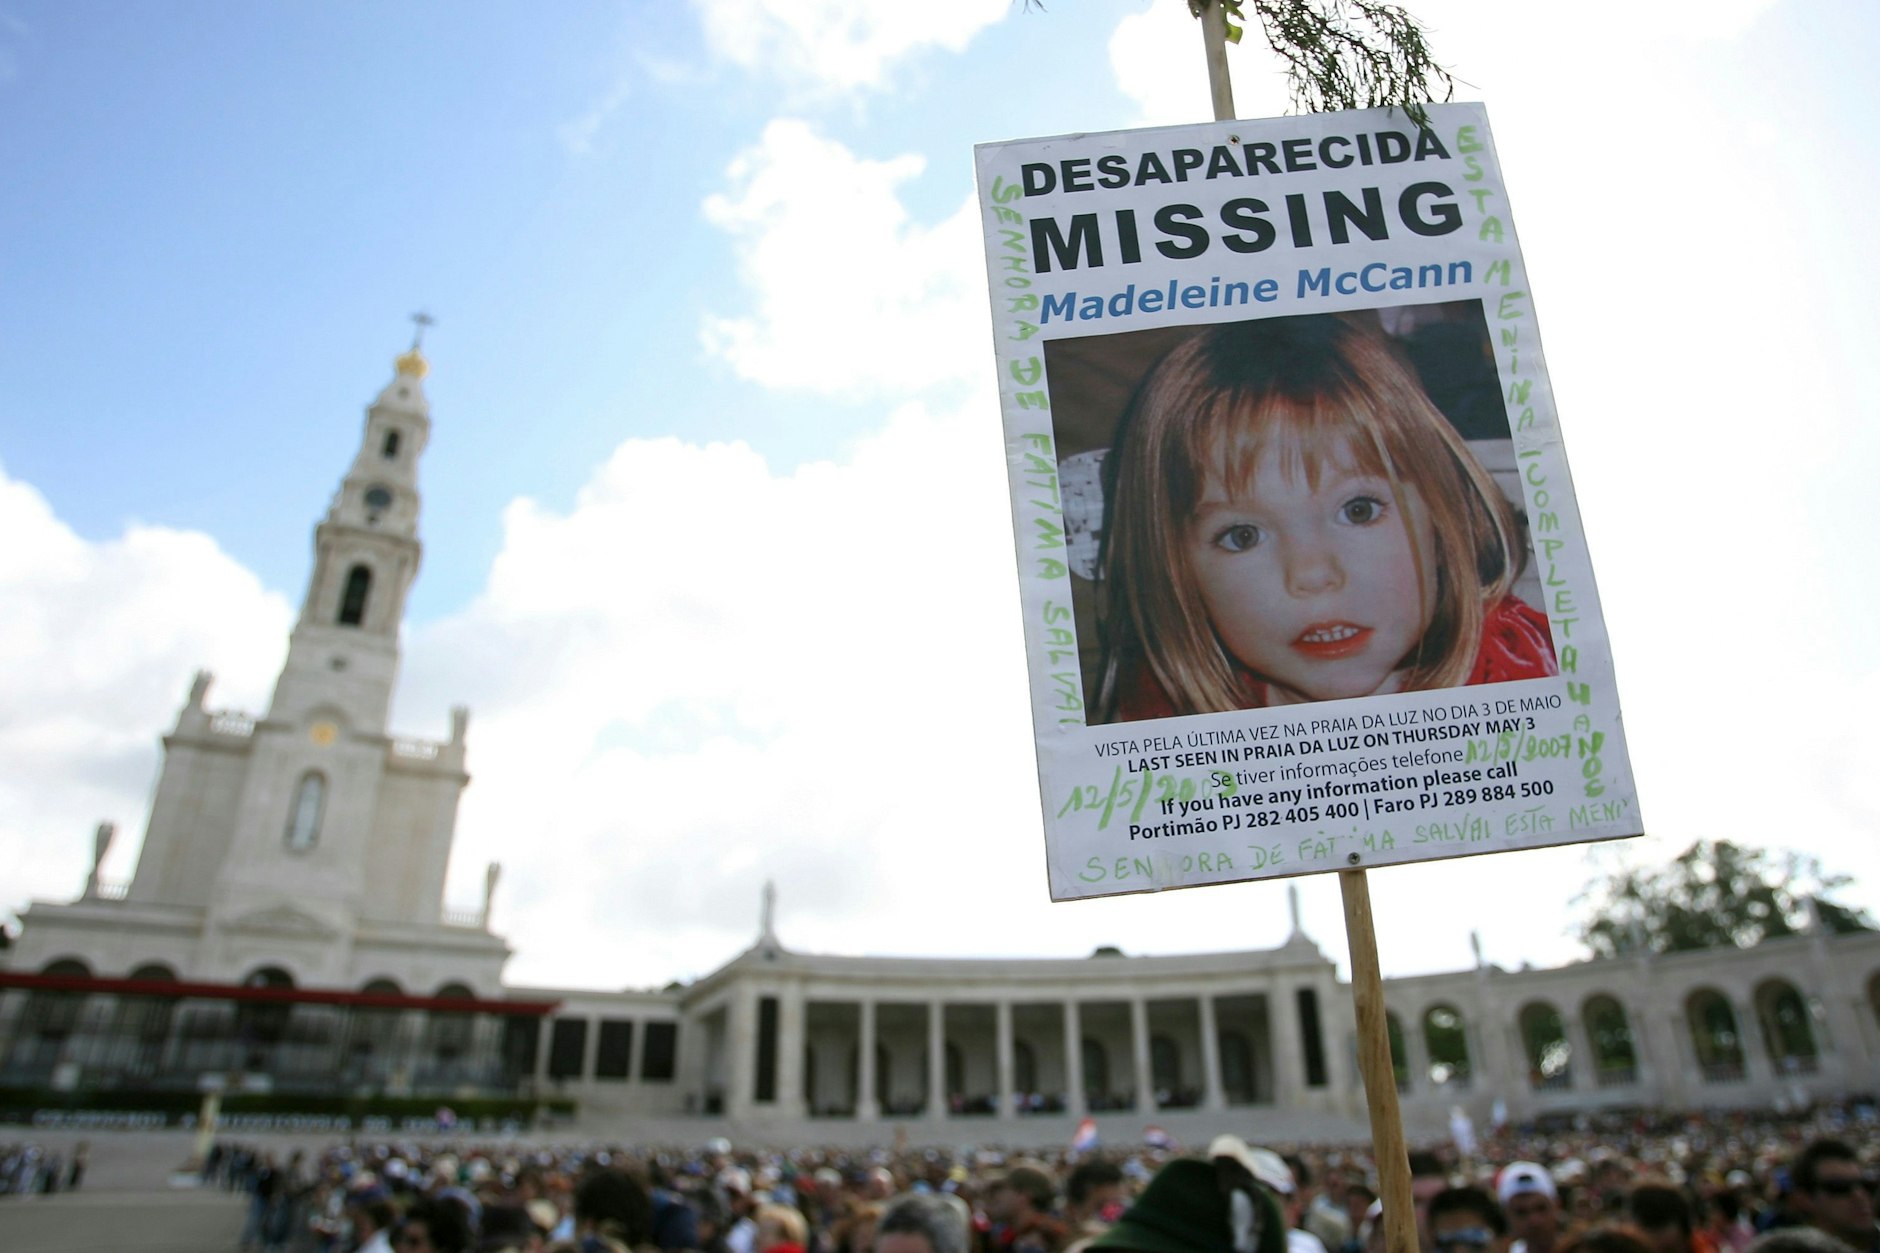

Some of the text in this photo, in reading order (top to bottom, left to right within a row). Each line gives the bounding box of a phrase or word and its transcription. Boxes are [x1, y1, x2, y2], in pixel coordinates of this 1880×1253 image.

[1021, 129, 1451, 197] DESAPARECIDA
[991, 175, 1040, 341] SENHORA
[1029, 181, 1463, 274] MISSING
[1040, 260, 1473, 325] Madeleine McCann
[1010, 356, 1049, 410] DE
[1456, 125, 1505, 244] ESTA
[1526, 462, 1580, 674] COMPLETA
[1095, 694, 1562, 757] VISTA PELA ÚLTIMA VEZ NA PRAIA DA LUZ NO DIA 3 DE MAIO
[1128, 717, 1535, 773] LAST SEEN IN PRAIA DA LUZ ON THURSDAY MAY 3
[1161, 761, 1518, 817] If you have any information please call
[1211, 749, 1463, 788] Se tiver informações telefone
[1130, 780, 1554, 840] Portimão PJ 282 405 400 Faro PJ 289 884 500
[1079, 850, 1234, 883] SENORA
